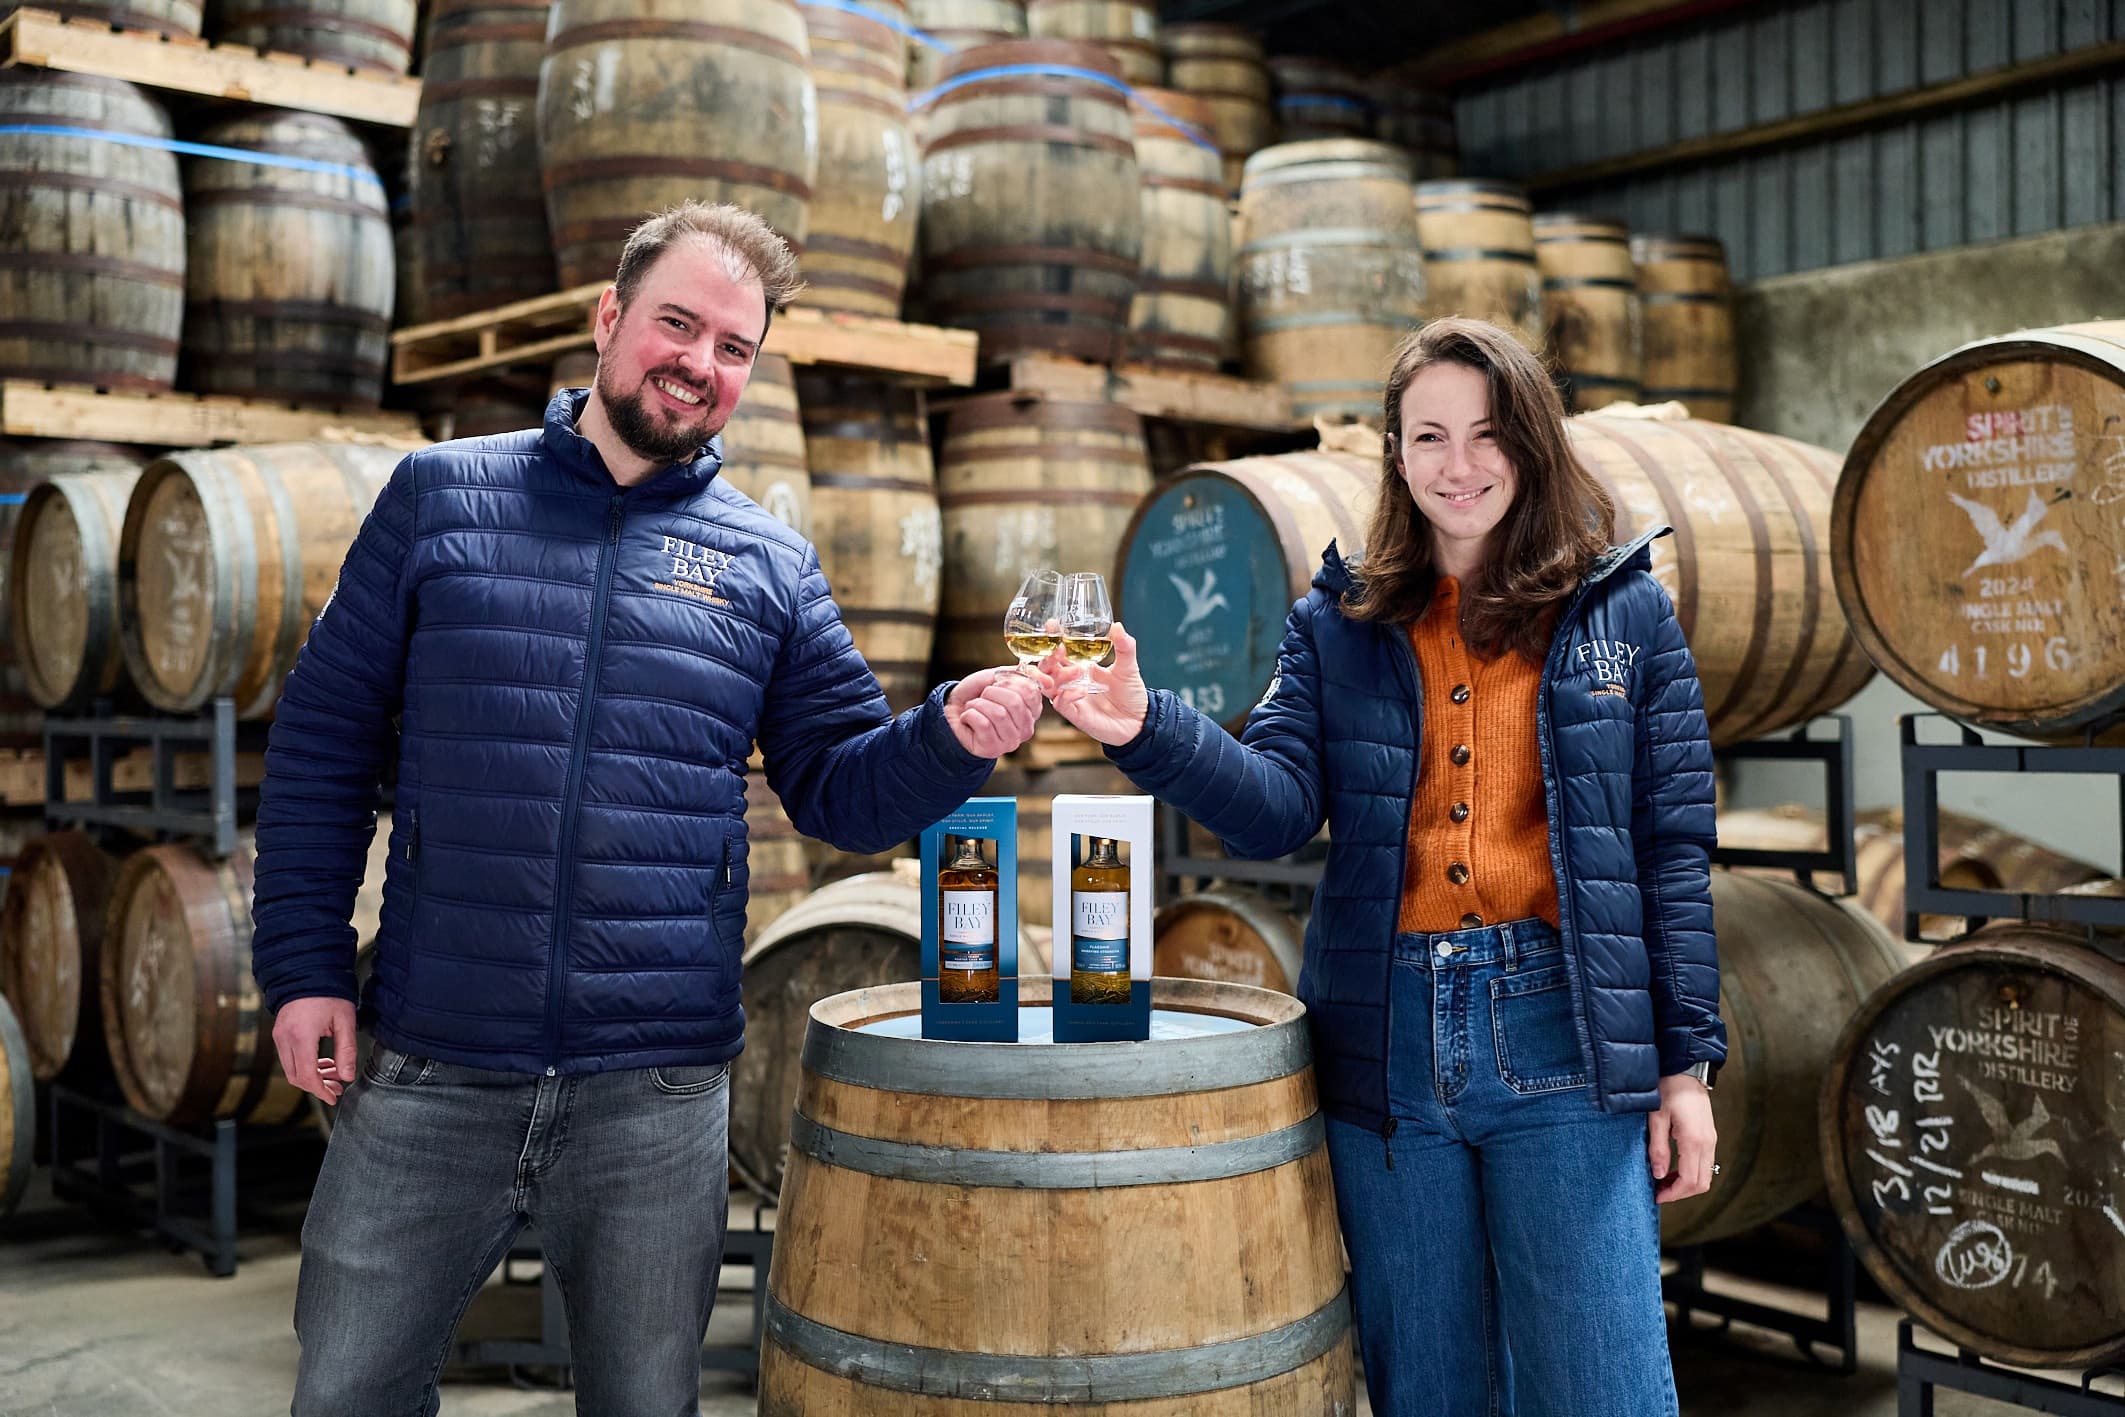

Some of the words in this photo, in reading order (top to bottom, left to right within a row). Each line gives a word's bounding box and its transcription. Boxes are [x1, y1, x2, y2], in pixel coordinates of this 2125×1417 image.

[661, 535, 736, 569] FILEY
[671, 557, 722, 586] BAY
[1576, 640, 1640, 666] FILEY
[948, 902, 992, 916] FILEY
[1082, 902, 1119, 914] FILEY
[955, 916, 984, 929] BAY
[1088, 914, 1113, 926] BAY
[1977, 1007, 2060, 1038] SPIRIT
[1927, 1024, 2080, 1069] YORKSHIRE
[1976, 1209, 2016, 1230] CSK
